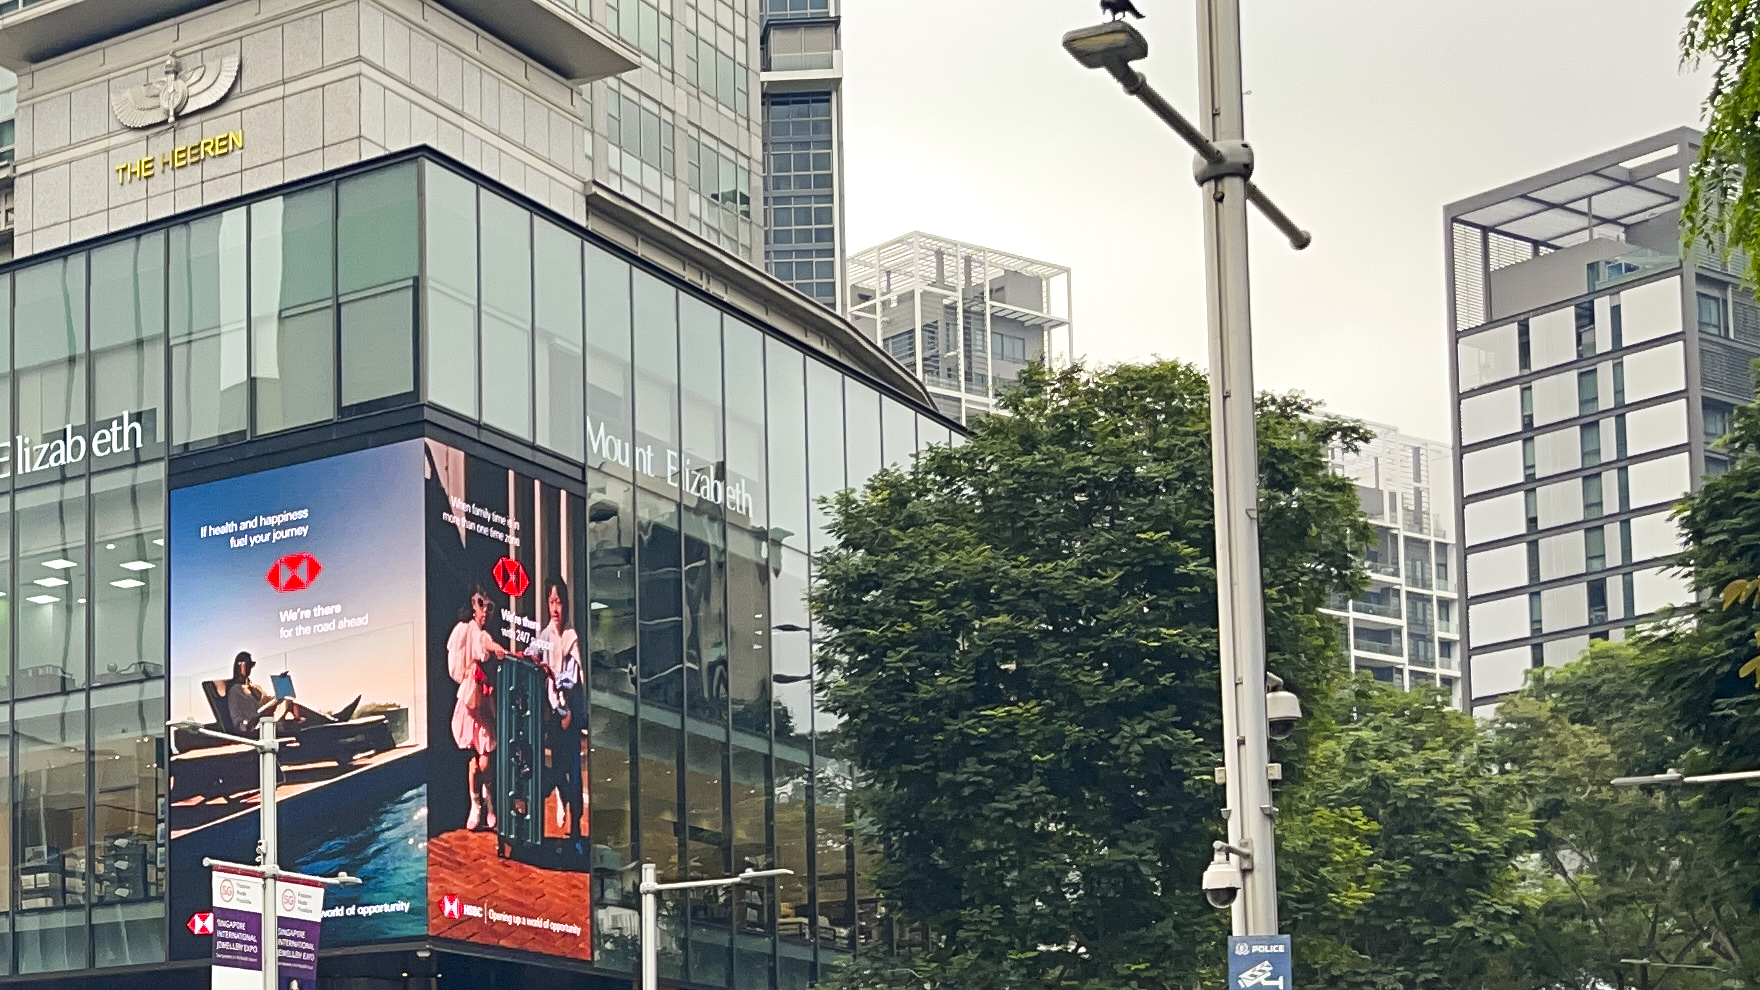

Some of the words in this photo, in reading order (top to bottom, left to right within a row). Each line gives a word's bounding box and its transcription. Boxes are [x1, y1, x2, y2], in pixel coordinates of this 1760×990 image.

[115, 155, 154, 186] THE
[160, 129, 244, 174] HEEREN
[586, 415, 655, 478] Mount
[666, 448, 754, 519] Elizabeth
[450, 496, 471, 513] When
[472, 503, 491, 522] family
[200, 526, 207, 538] If
[209, 521, 238, 537] health
[239, 516, 257, 531] and
[260, 508, 309, 527] happiness
[230, 534, 247, 548] fuel
[249, 532, 271, 547] your
[272, 525, 309, 543] journey
[279, 607, 311, 622] We're
[313, 603, 342, 617] there
[279, 626, 293, 639] for
[295, 624, 311, 637] the
[313, 619, 335, 634] road
[337, 613, 369, 629] ahead
[515, 629, 530, 644] 24/7
[346, 905, 356, 917] of
[356, 900, 411, 916] opportunity
[463, 904, 483, 918] HSBC
[488, 908, 513, 925] Opening
[513, 915, 521, 926] up
[549, 921, 581, 937] opportunity
[1251, 944, 1285, 953] POLICE
